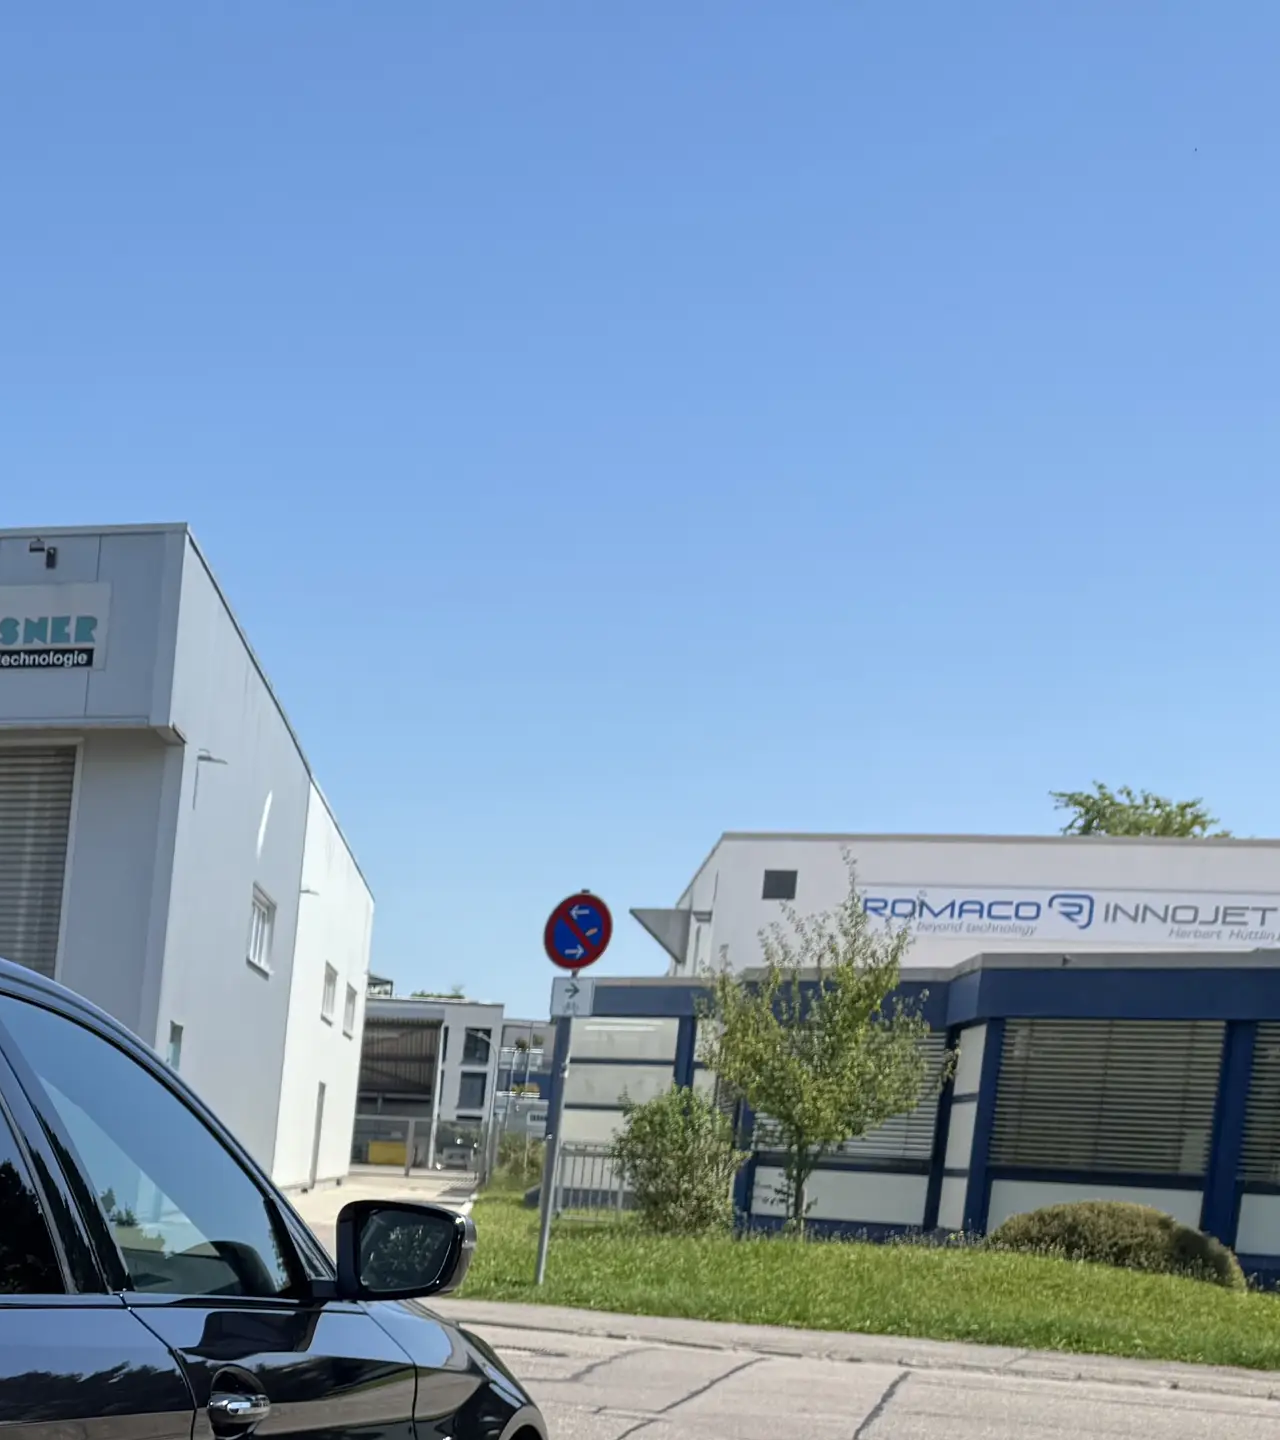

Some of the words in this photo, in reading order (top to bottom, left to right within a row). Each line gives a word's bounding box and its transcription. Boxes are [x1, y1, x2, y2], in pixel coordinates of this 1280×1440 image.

[863, 897, 1042, 921] ROMACO
[1103, 903, 1279, 927] INNOJET
[916, 920, 964, 934] beyond
[966, 921, 1038, 936] technology
[1168, 927, 1222, 939] Herbert
